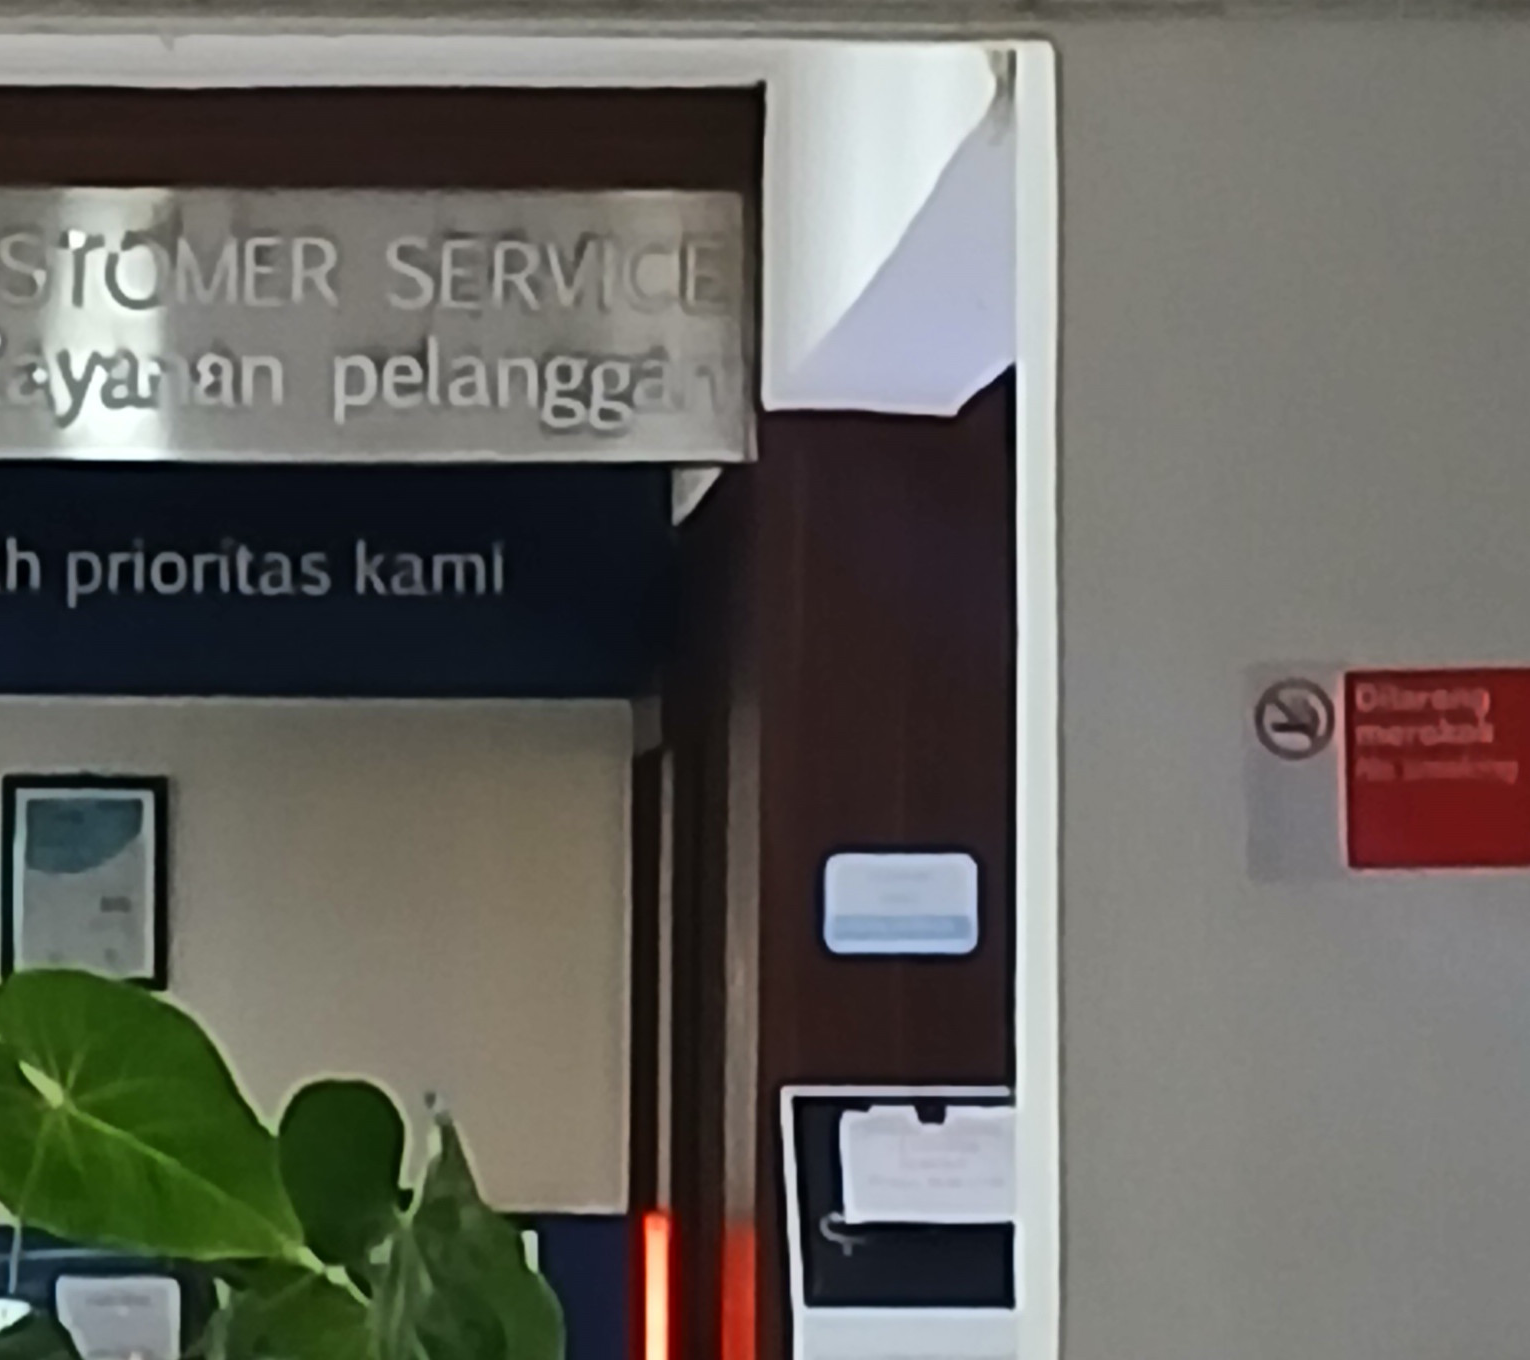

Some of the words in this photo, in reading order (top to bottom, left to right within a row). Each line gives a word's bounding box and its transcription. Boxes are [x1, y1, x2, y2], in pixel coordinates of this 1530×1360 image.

[385, 231, 729, 315] SERVICE
[333, 333, 721, 435] pelanggan
[67, 536, 331, 608] prioritas
[356, 538, 505, 597] kami
